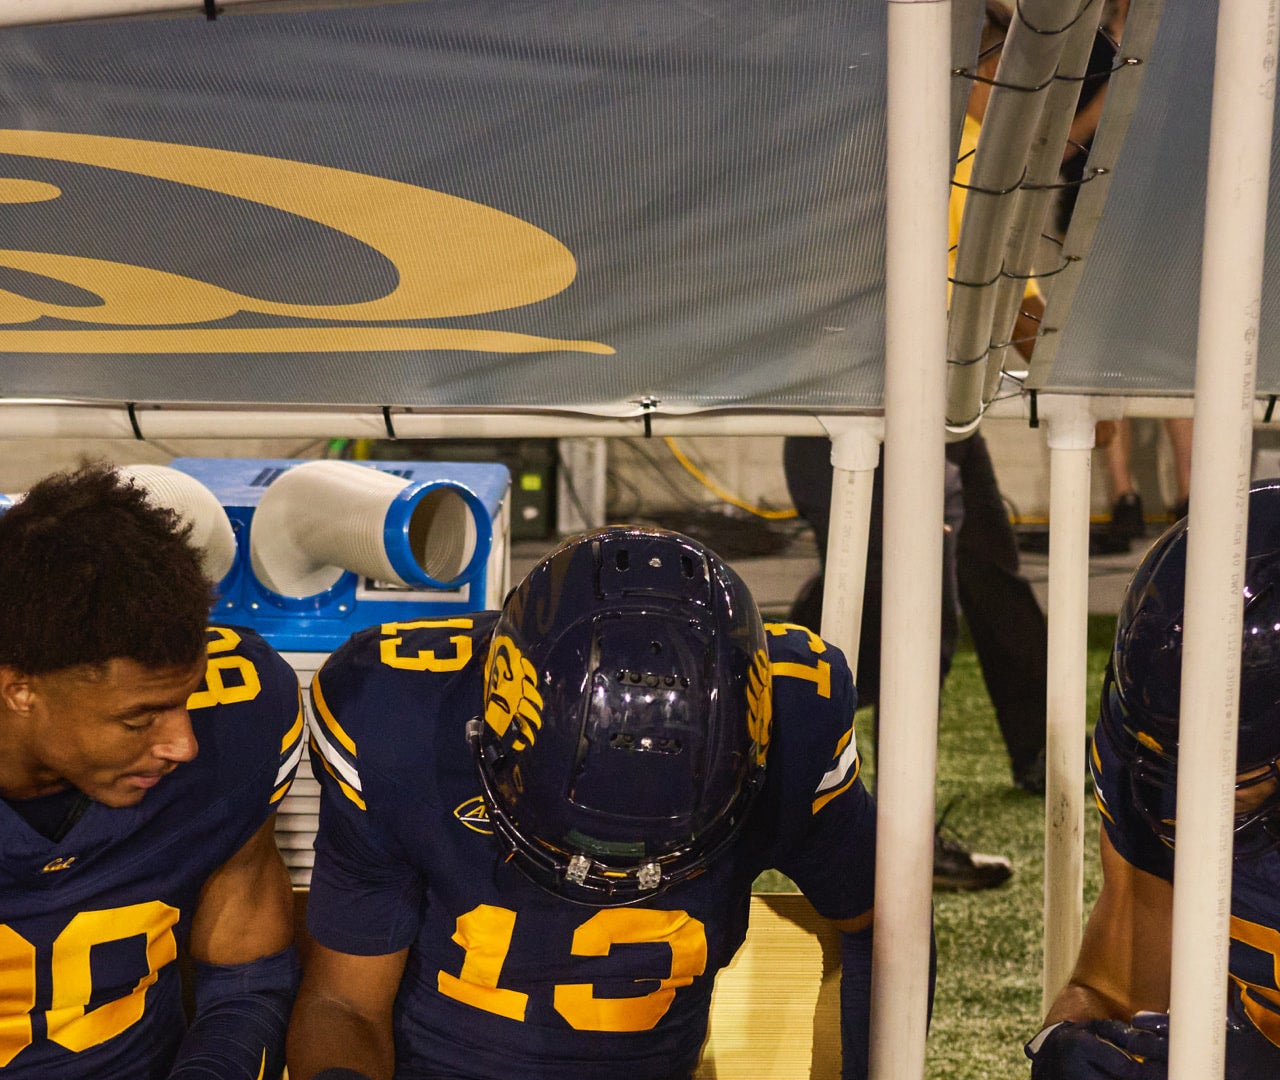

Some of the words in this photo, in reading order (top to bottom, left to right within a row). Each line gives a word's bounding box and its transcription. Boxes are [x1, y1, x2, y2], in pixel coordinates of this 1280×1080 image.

[380, 618, 474, 673] 13
[38, 856, 78, 875] Cal
[436, 903, 707, 1032] 13
